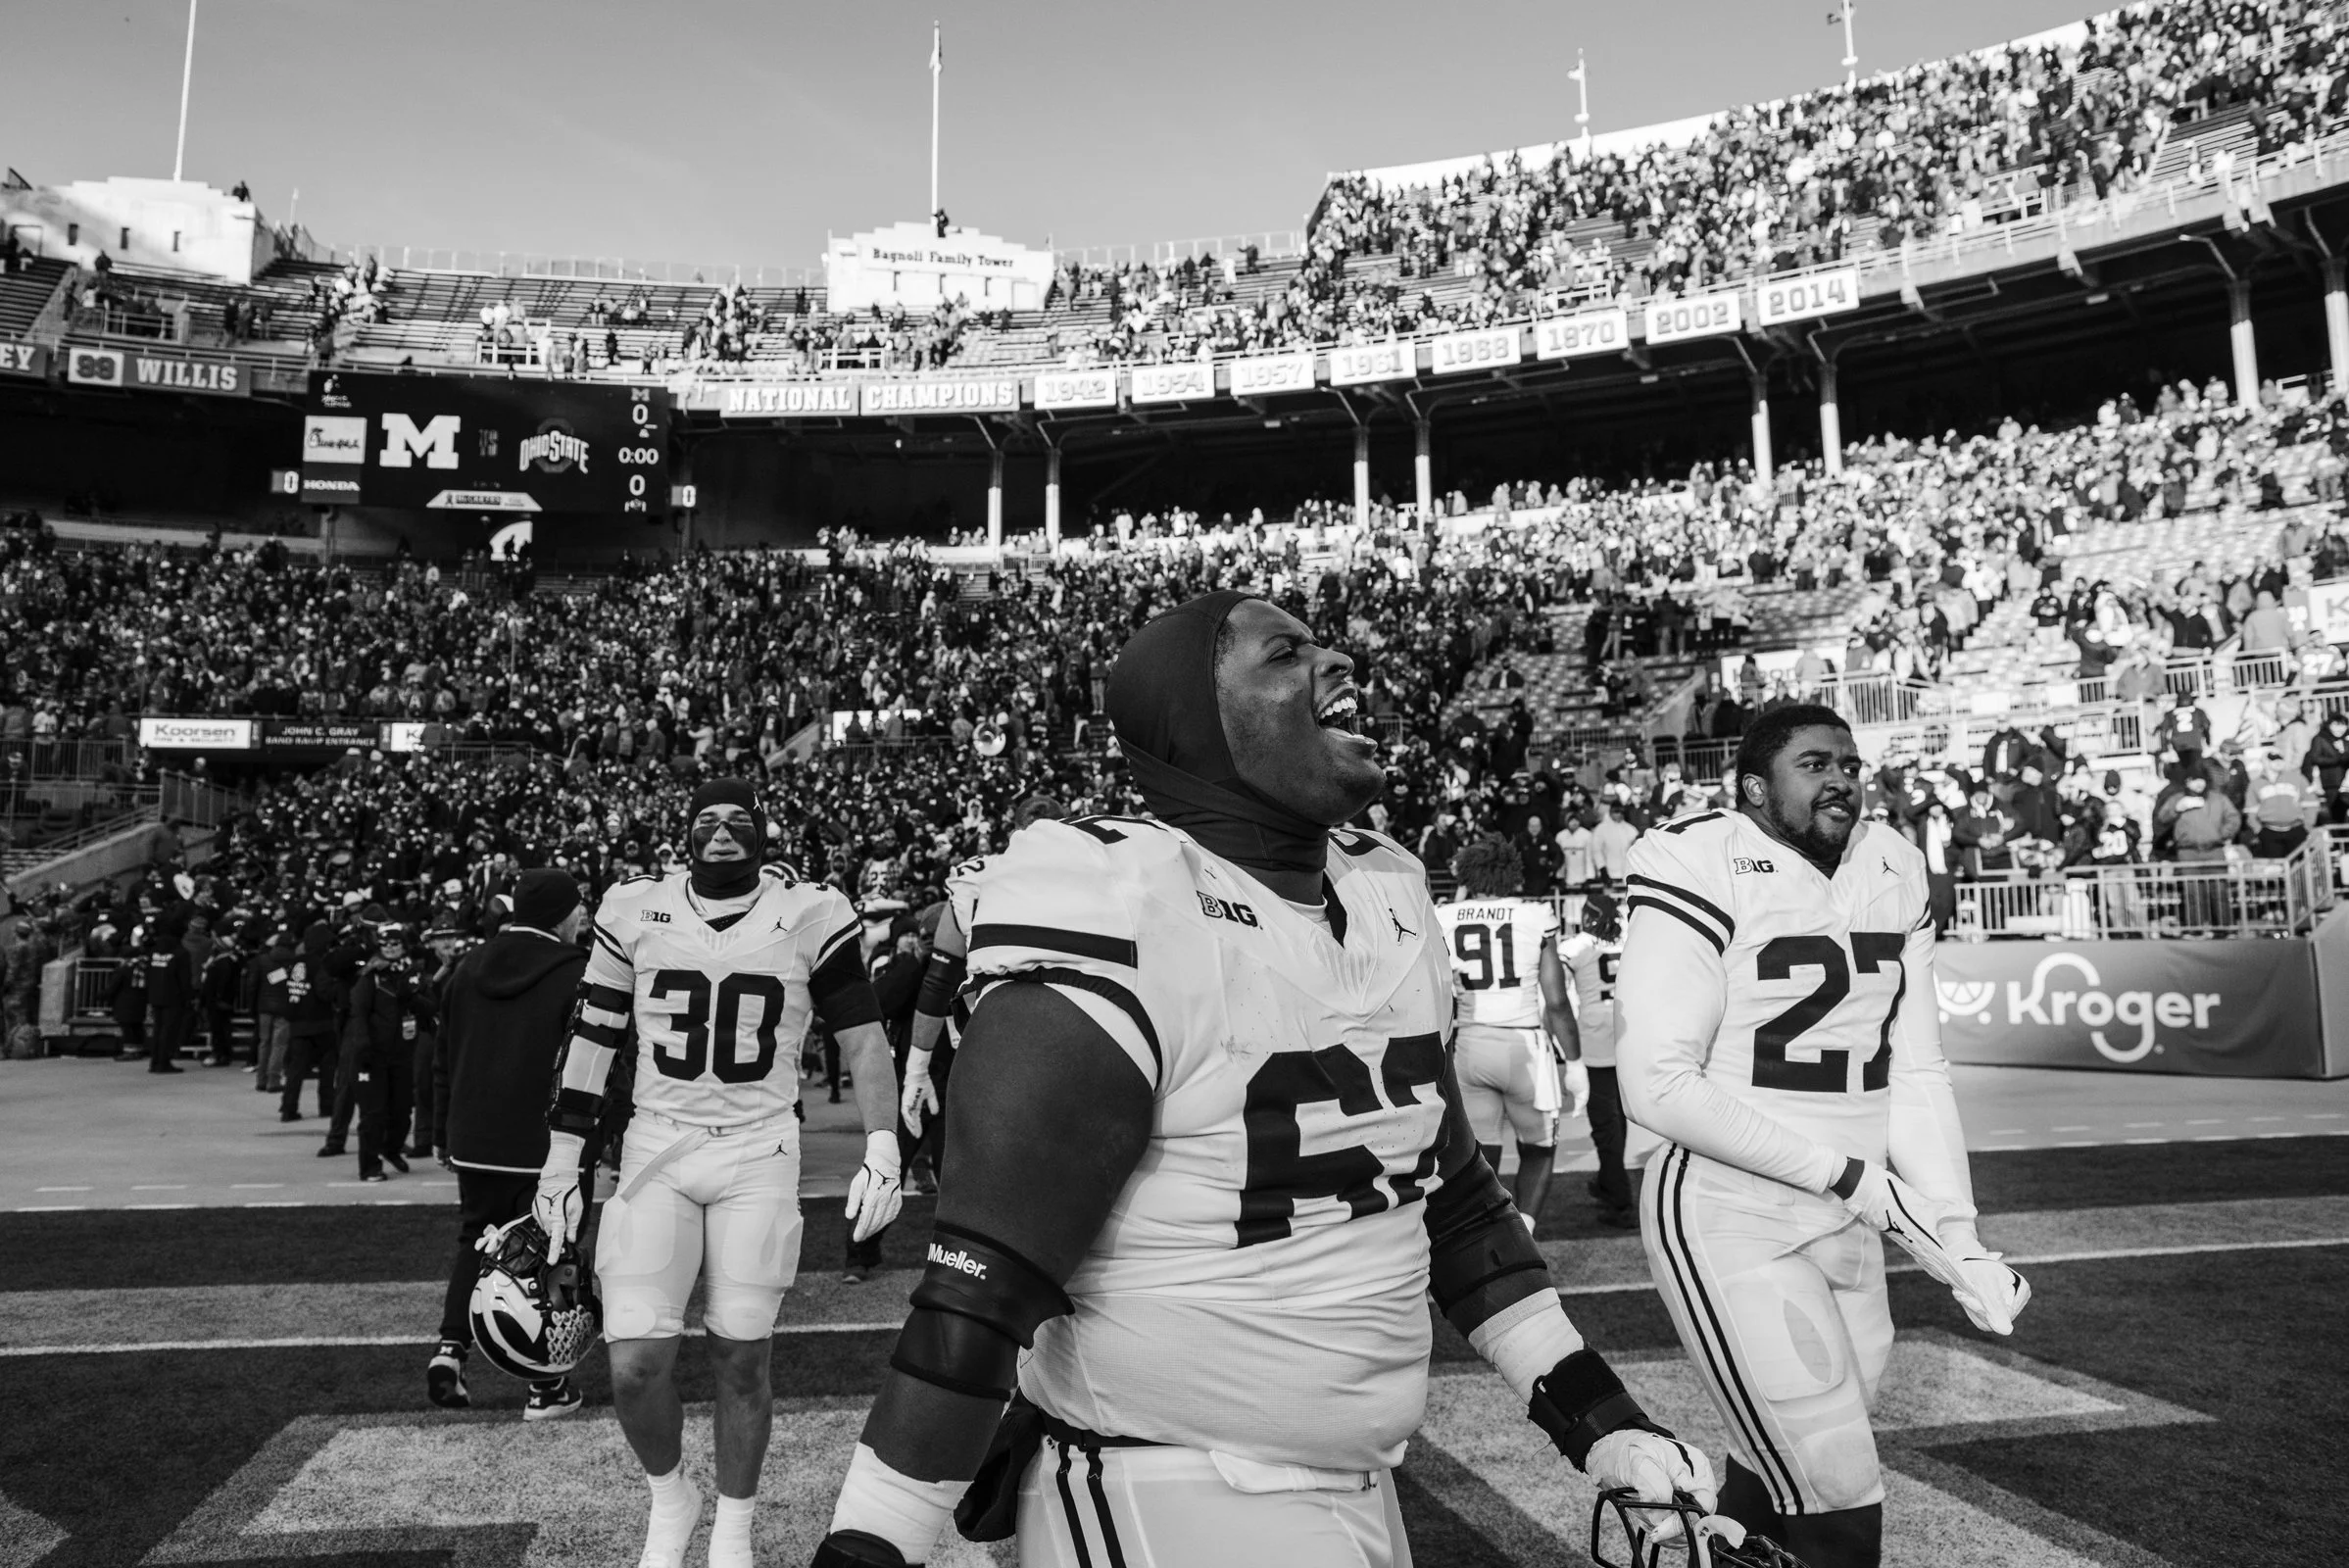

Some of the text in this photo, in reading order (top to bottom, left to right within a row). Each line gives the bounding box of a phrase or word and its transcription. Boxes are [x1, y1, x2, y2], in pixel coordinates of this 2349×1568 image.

[873, 248, 1013, 268] Bagnoli Family Tower
[1768, 278, 1847, 317] 2014
[1656, 300, 1730, 335] 2002
[1548, 319, 1616, 351] 1970
[1343, 349, 1403, 377] 1961
[1443, 336, 1510, 367] 1968
[136, 357, 238, 392] WILLIS
[1142, 370, 1204, 396] 1954
[1241, 362, 1303, 387] 1957
[728, 381, 1013, 414] NATIONAL CHAMPIONS
[1045, 379, 1106, 402] 1942
[632, 404, 649, 425] 0
[379, 413, 462, 470] M
[618, 447, 659, 465] 0:00
[284, 470, 299, 494] 0
[303, 479, 361, 491] HONDA
[629, 474, 646, 496] 0
[682, 485, 696, 508] 0
[155, 724, 235, 736] Koorsen
[282, 726, 313, 736] JOHN
[328, 727, 360, 737] GRAY
[1457, 907, 1515, 921] BRANDT
[1454, 922, 1521, 991] 91
[1751, 931, 1906, 1094] 27
[2007, 952, 2222, 1063] Kroger
[649, 968, 786, 1084] 30
